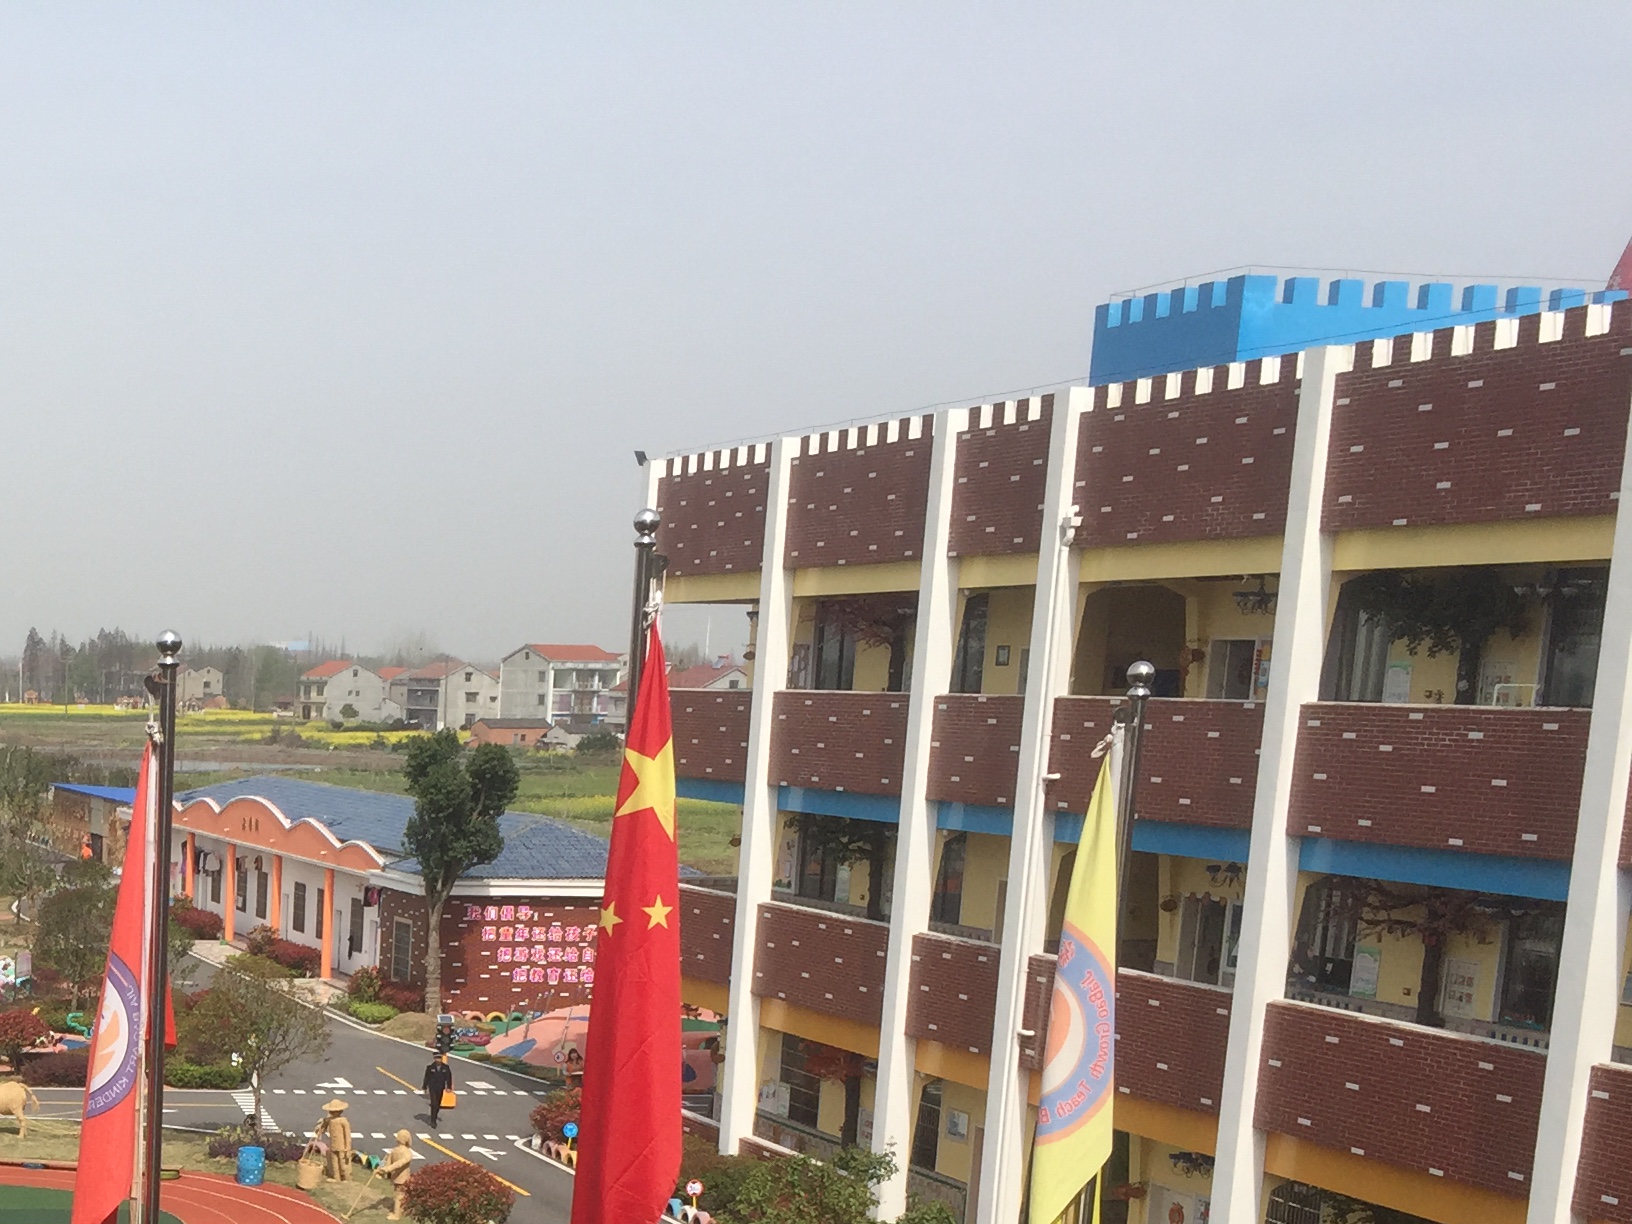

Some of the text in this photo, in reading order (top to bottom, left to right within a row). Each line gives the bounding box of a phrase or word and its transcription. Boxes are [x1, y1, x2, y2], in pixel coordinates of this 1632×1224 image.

[482, 926, 598, 941] 把童年还给孩子
[497, 947, 596, 962] 把游戏还给自
[512, 967, 594, 982] 把教育还给
